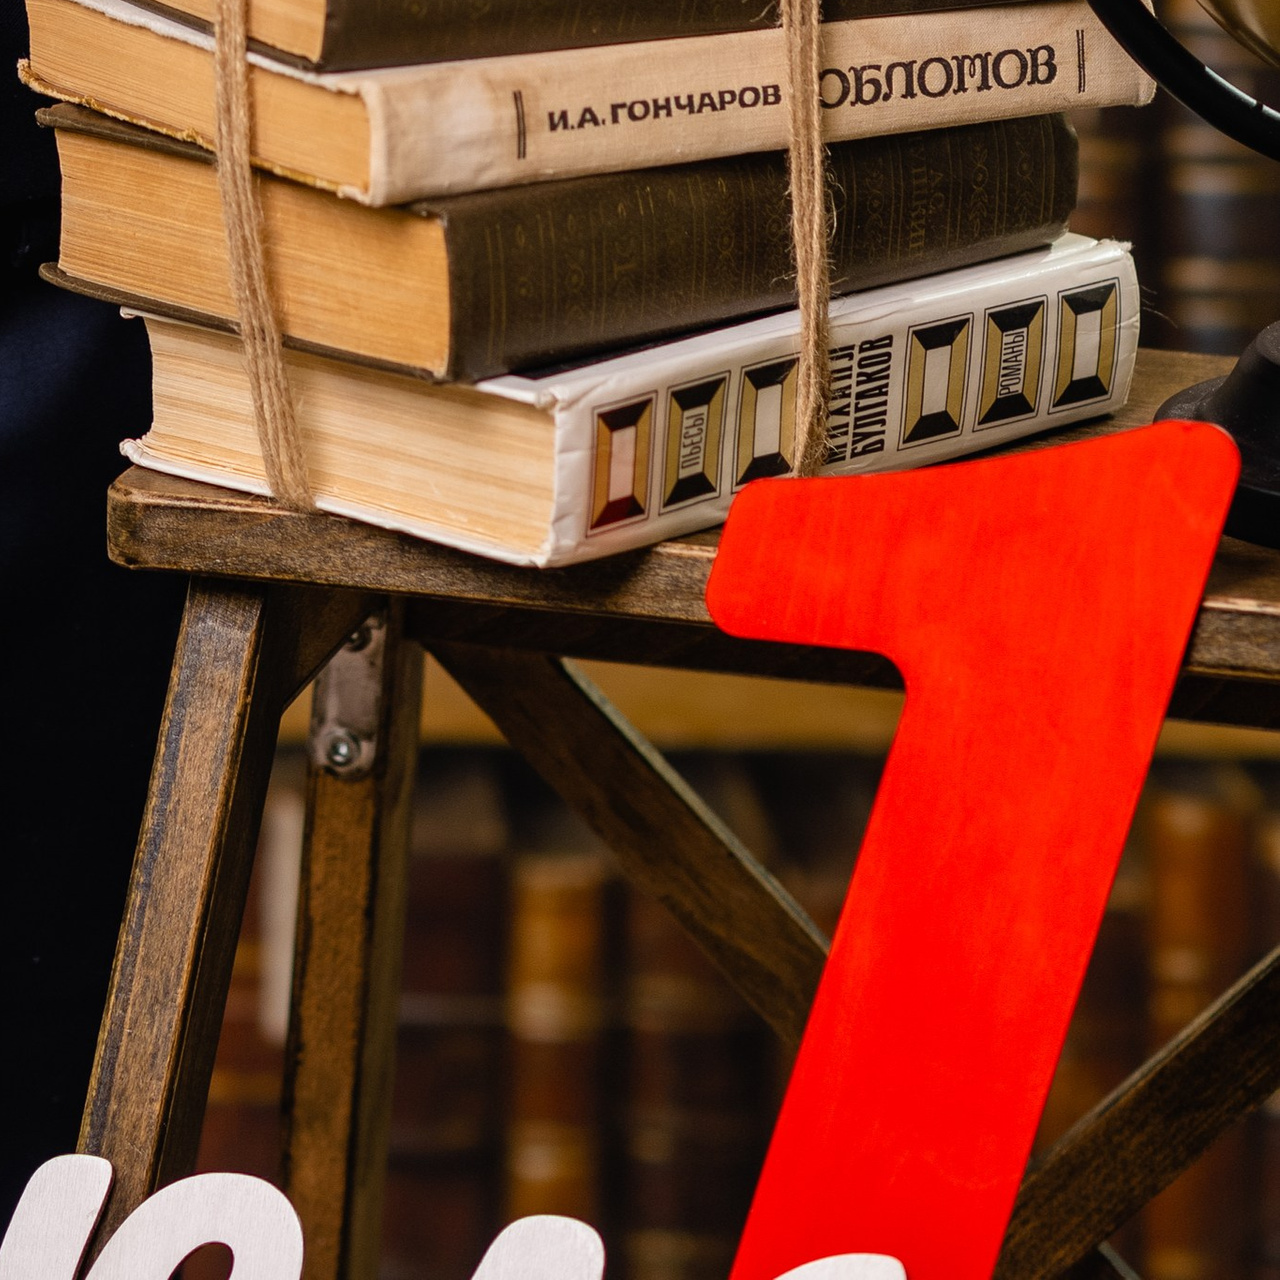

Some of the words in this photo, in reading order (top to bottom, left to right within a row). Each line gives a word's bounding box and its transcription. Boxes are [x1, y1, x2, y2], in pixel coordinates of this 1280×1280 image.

[818, 43, 1058, 111] ОБЛОМОВ
[849, 334, 894, 460] БУЛГАКОВ
[997, 329, 1027, 400] РОМАНЫ
[681, 412, 706, 471] ПЬЕСЫ
